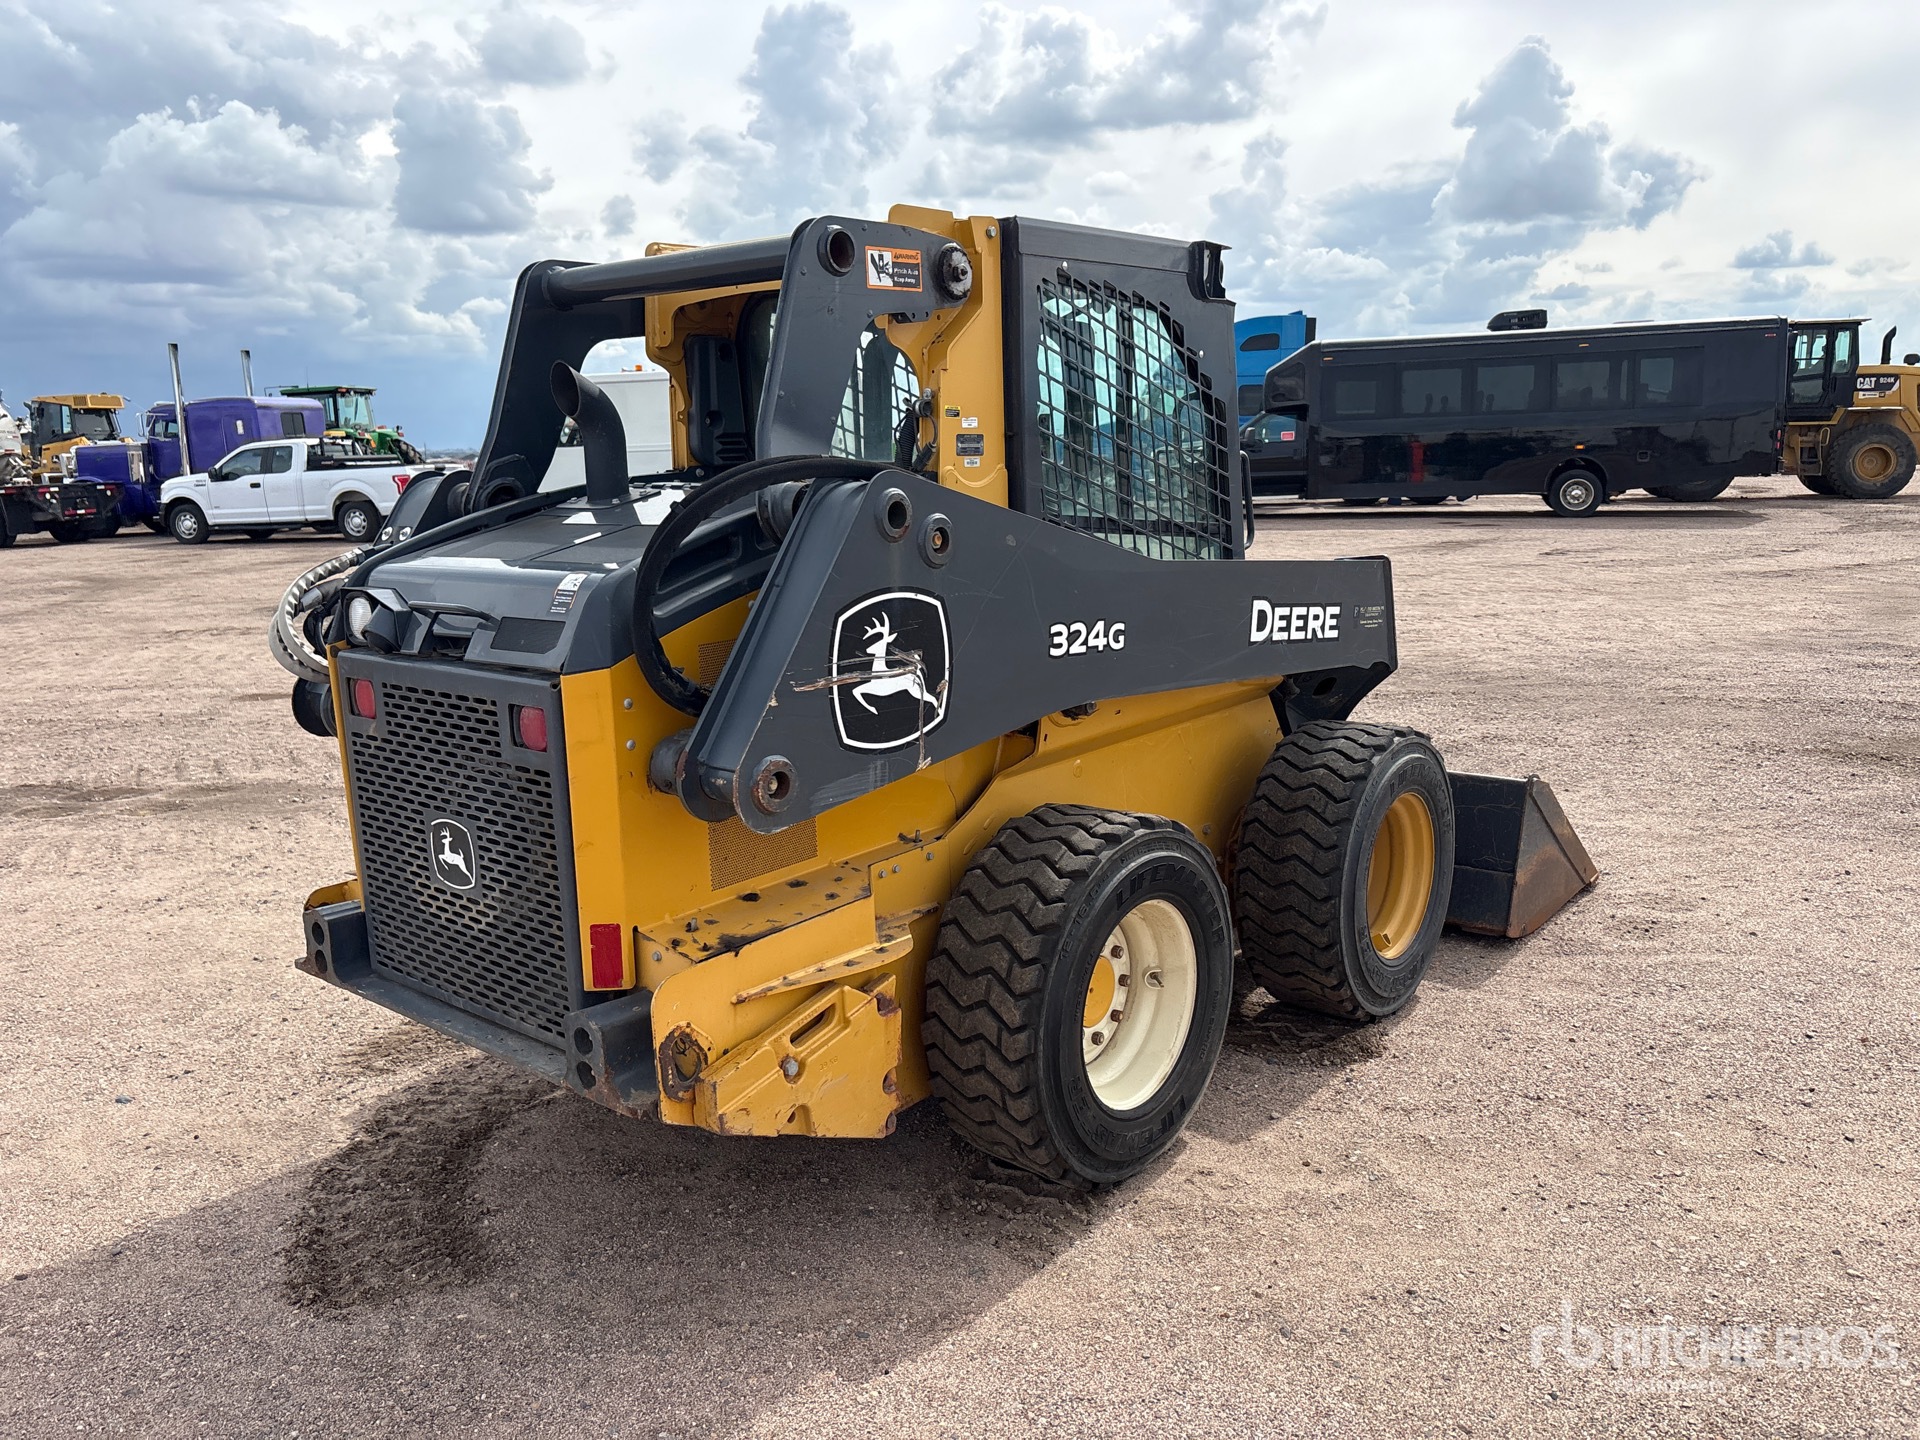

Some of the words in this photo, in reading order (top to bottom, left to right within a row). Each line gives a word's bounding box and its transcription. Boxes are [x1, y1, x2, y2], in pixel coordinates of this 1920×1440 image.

[894, 276, 904, 284] Keep
[1857, 377, 1876, 389] CAT
[1250, 599, 1341, 643] DEERE
[1049, 620, 1126, 657] 324G
